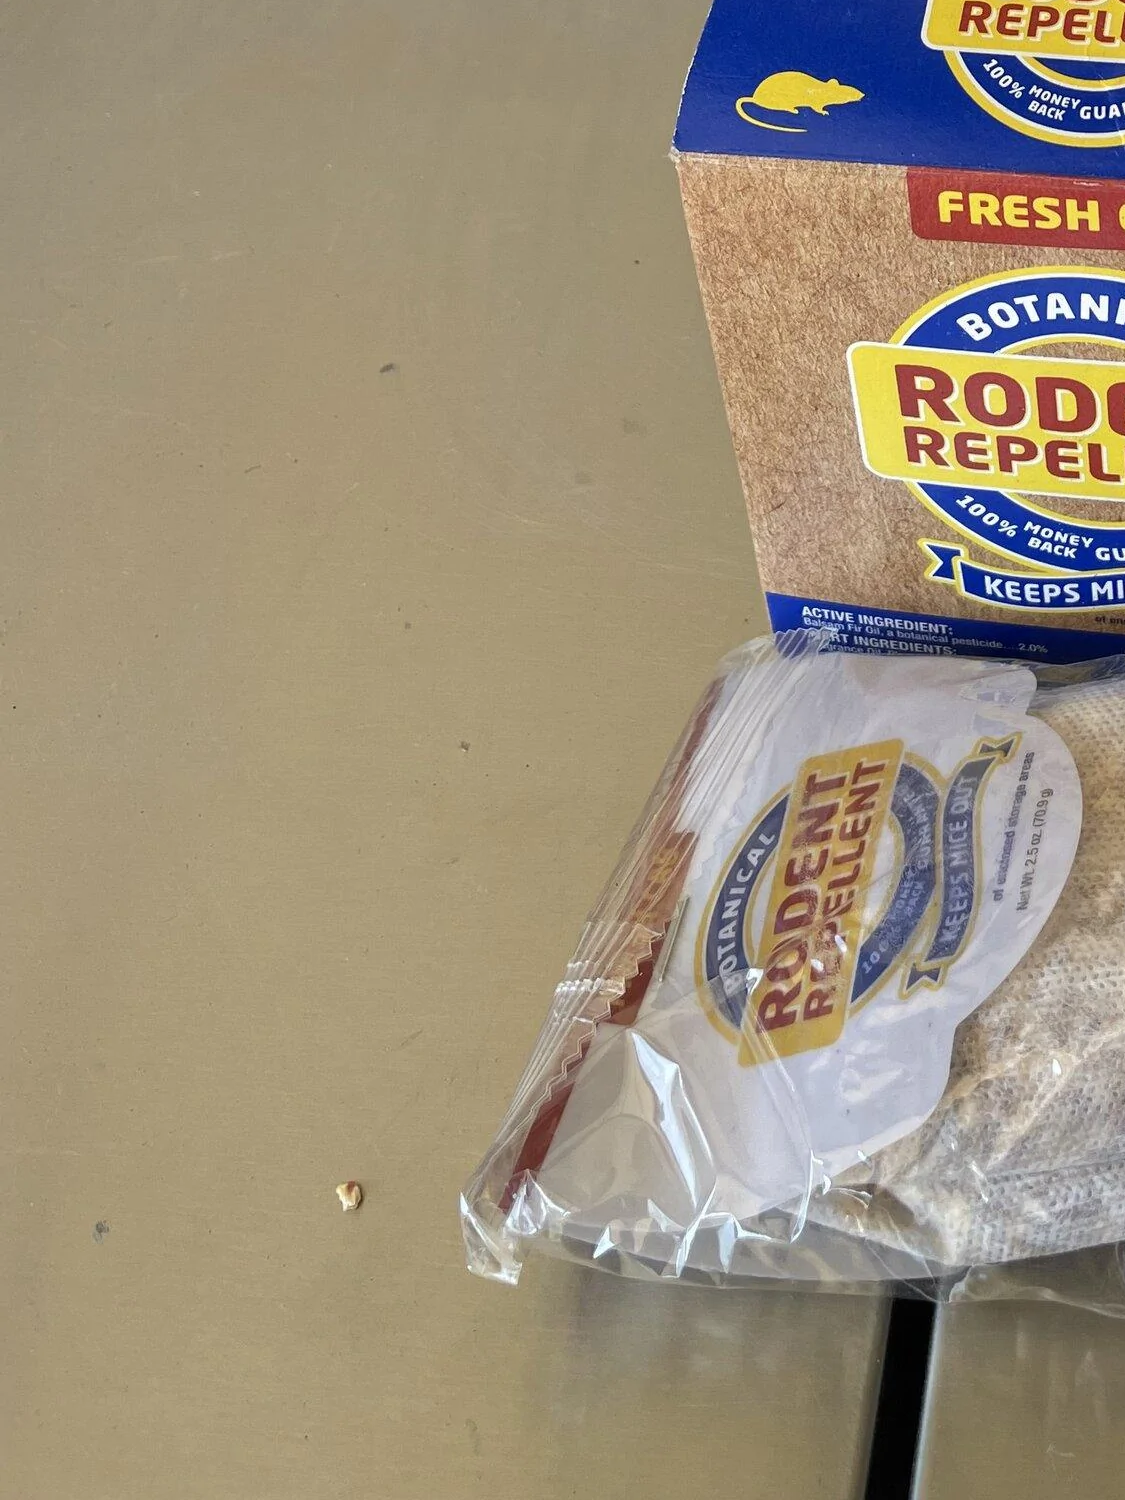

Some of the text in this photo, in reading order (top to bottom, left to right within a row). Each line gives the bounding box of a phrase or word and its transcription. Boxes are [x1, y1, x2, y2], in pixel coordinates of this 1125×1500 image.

[982, 58, 1026, 100] 100%
[1028, 84, 1082, 111] MONEY
[1028, 100, 1066, 122] BACK
[937, 190, 1101, 232] FRESH
[955, 493, 1018, 539] 100%
[1023, 520, 1094, 550] MONEY
[1027, 536, 1078, 560] BACK
[983, 574, 1081, 605] KEEPS
[801, 606, 954, 636] ACTIVE INGREDIENT:
[847, 622, 864, 634] Fir
[886, 629, 895, 638] a
[896, 629, 949, 644] botanical
[853, 634, 958, 656] INGREDIENTS:
[1009, 782, 1027, 829] storage
[1019, 751, 1034, 782] areas
[942, 776, 978, 944] KEEPS MICE OUT
[1016, 890, 1032, 911] Net
[1025, 848, 1039, 867] 2.5
[718, 830, 777, 997] BOTANICAL
[756, 773, 849, 1033] RODENT
